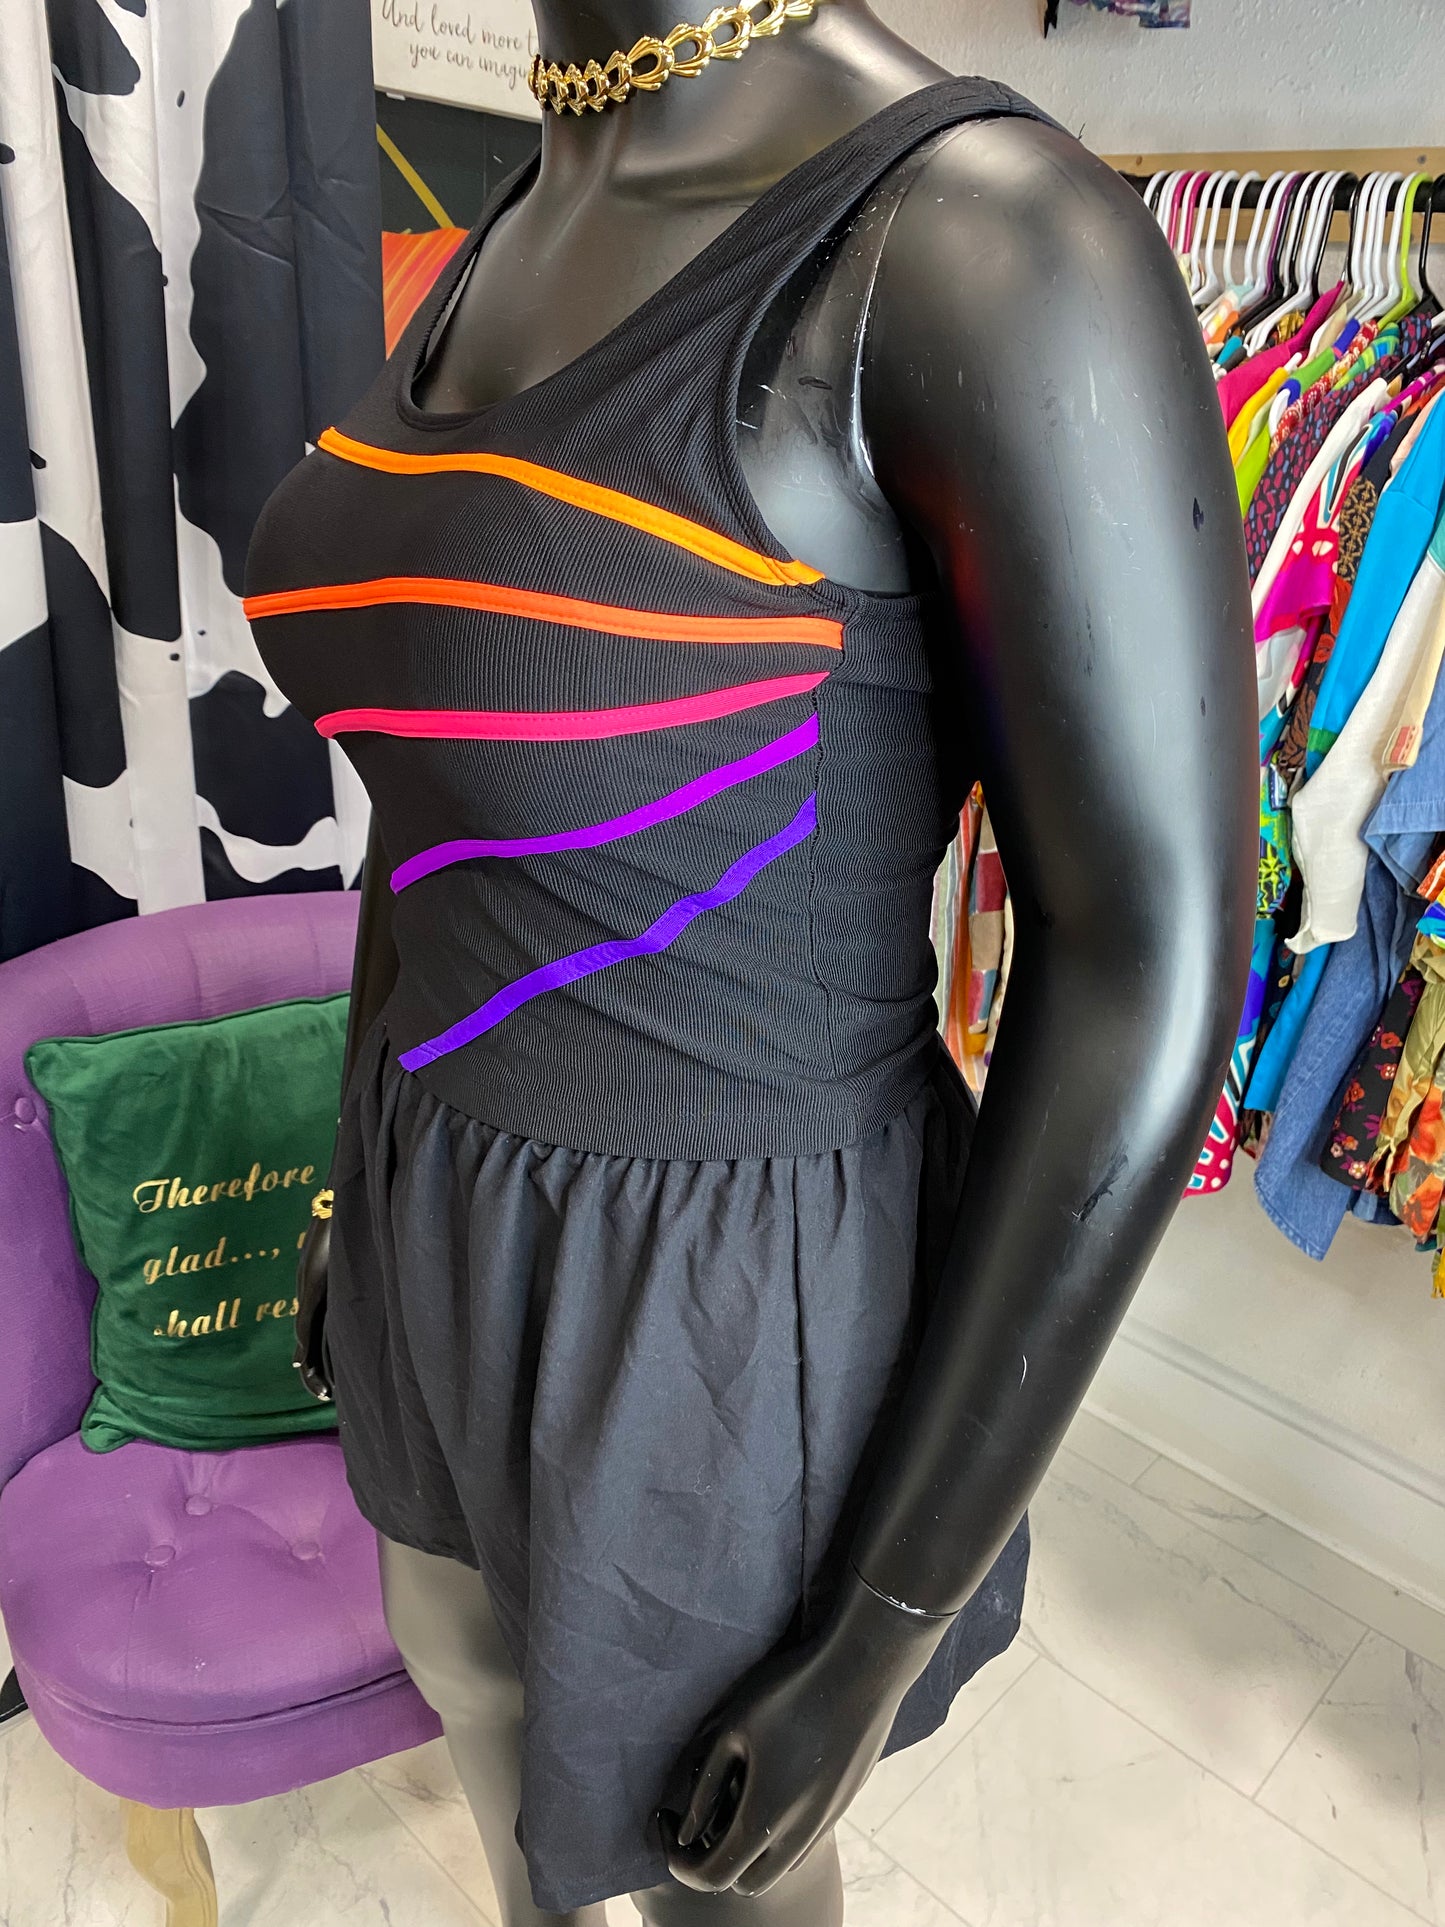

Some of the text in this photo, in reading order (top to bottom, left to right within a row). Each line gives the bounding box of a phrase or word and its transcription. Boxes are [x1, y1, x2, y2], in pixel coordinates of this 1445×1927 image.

[381, 0, 424, 32] And
[431, 3, 476, 44] loved
[481, 29, 521, 49] more
[409, 43, 440, 68] you
[446, 54, 473, 70] can
[132, 1161, 316, 1213] Therefore
